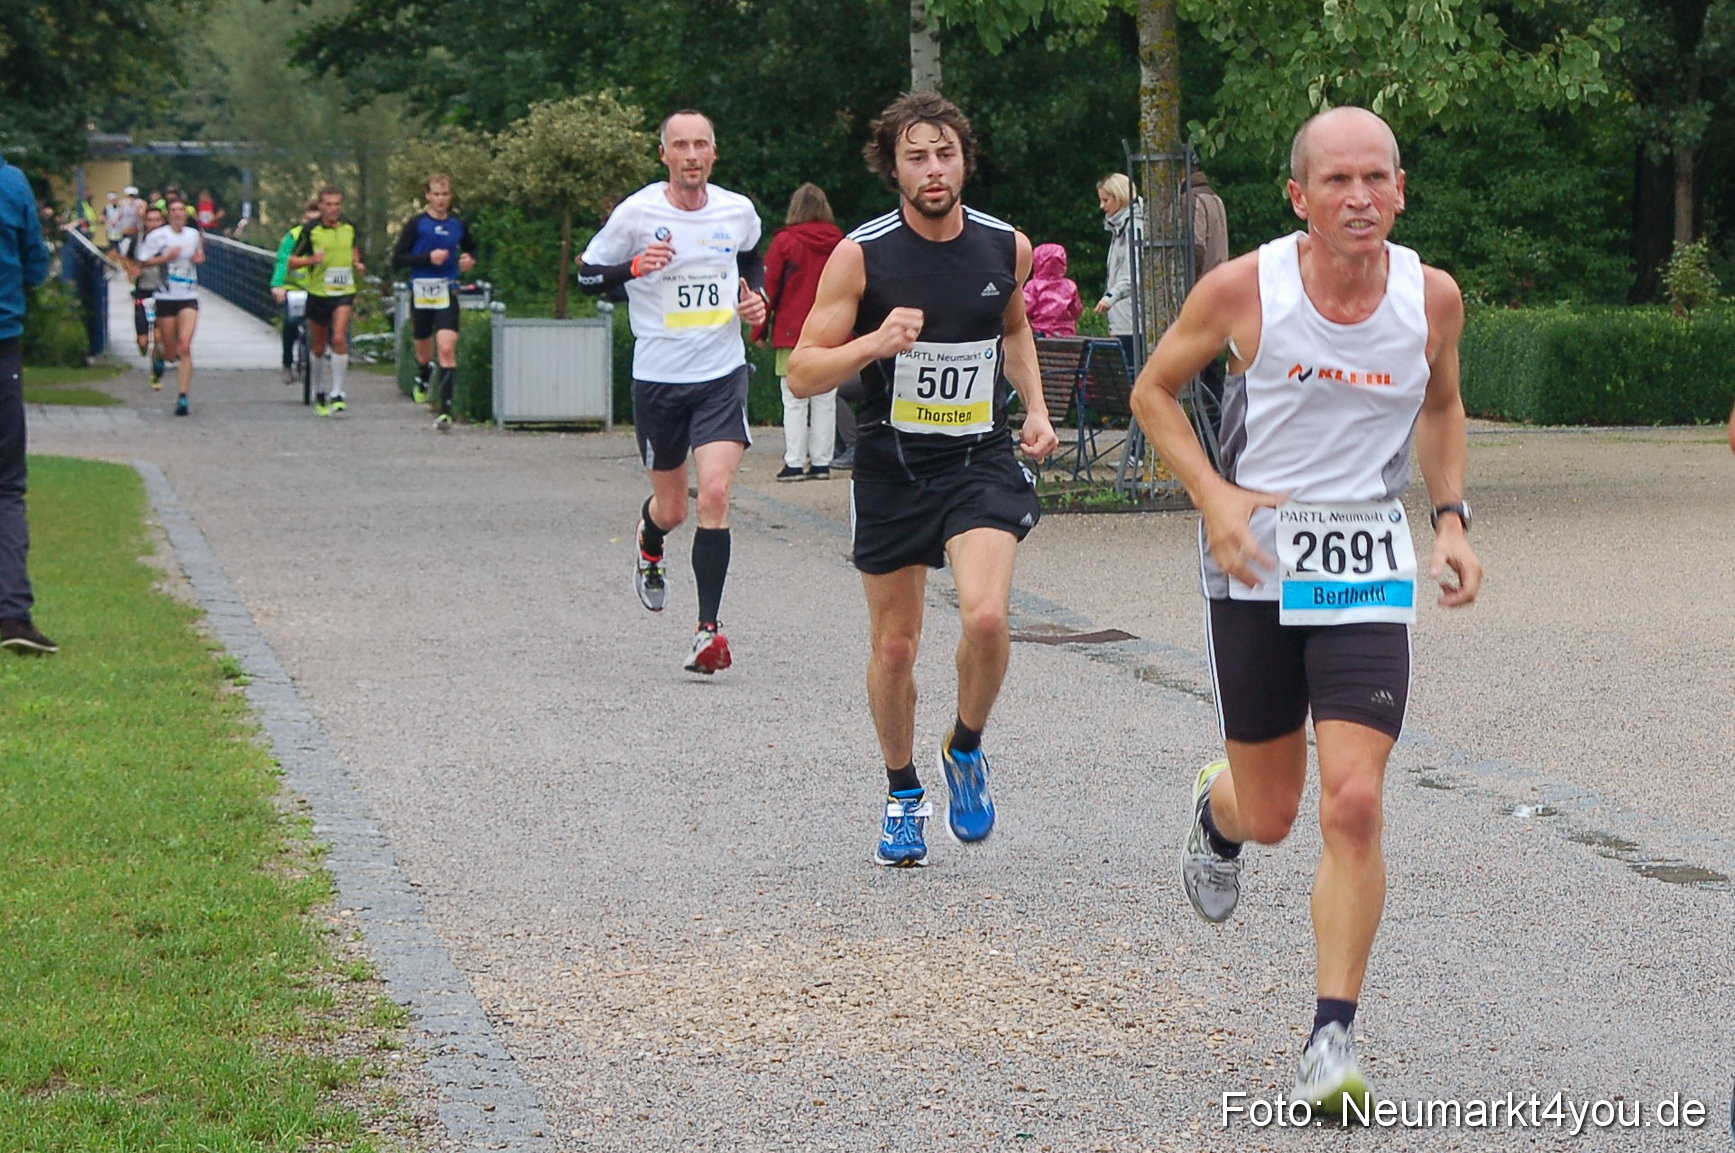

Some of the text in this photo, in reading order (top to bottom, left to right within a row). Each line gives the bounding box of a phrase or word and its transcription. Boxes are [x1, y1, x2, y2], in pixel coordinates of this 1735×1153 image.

[678, 283, 720, 308] 578
[900, 350, 982, 362] PARTL Neumarkt
[916, 366, 979, 400] 507
[917, 407, 972, 424] Thorsten
[1280, 510, 1326, 523] PARTL
[1292, 530, 1399, 575] 2691
[1285, 570, 1291, 578] A
